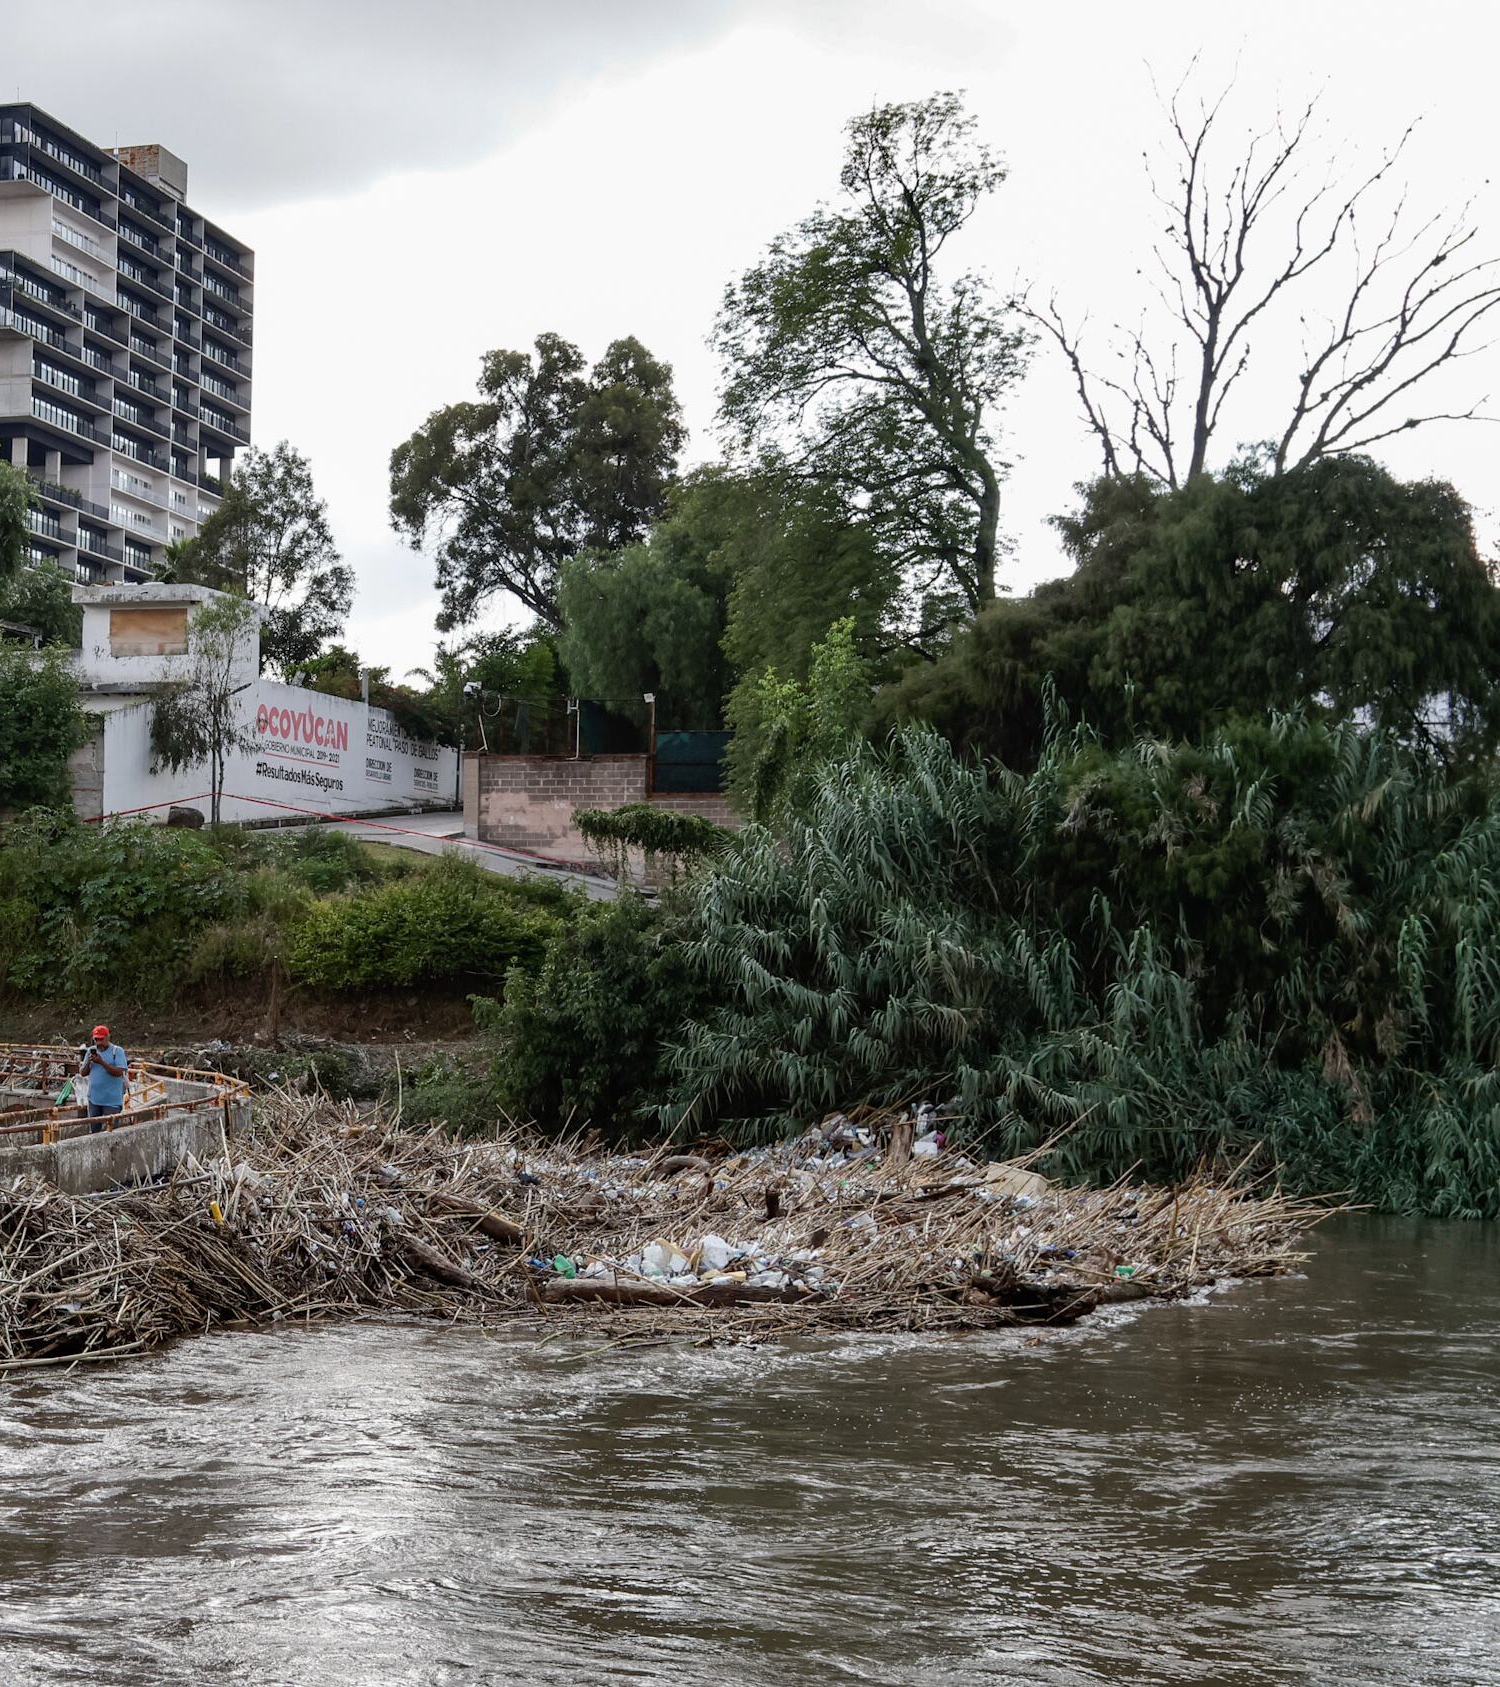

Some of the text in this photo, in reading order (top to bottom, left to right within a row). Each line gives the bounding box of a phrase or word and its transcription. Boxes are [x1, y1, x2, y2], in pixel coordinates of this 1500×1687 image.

[257, 703, 348, 752] OCOYUCAN
[265, 739, 290, 753] GOBIERNO
[290, 745, 315, 759] MUNICIPAL
[367, 733, 392, 751] PEATONAL
[411, 743, 418, 757] DE
[386, 761, 393, 773] DE
